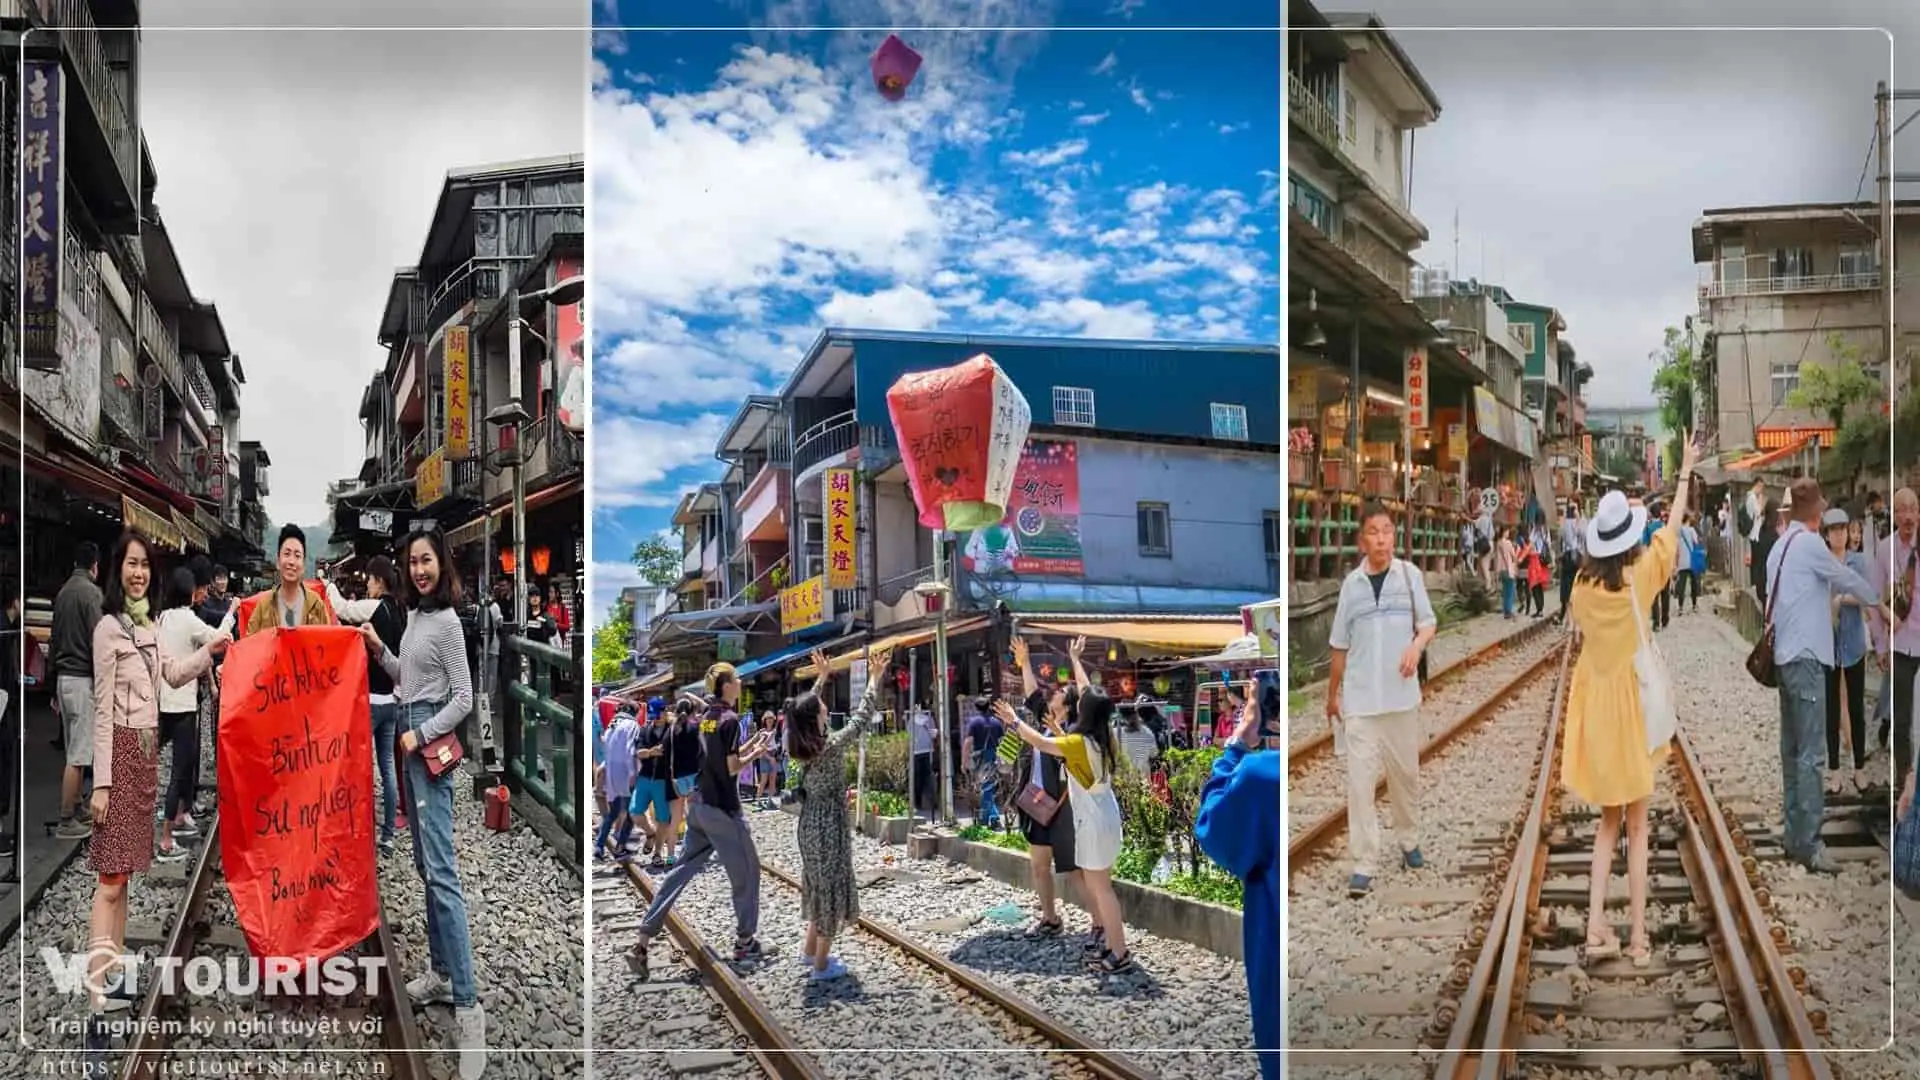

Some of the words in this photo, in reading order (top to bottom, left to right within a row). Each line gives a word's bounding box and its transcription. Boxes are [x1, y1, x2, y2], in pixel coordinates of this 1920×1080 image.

[831, 472, 851, 572] 胡家天燈
[1482, 493, 1498, 507] 25
